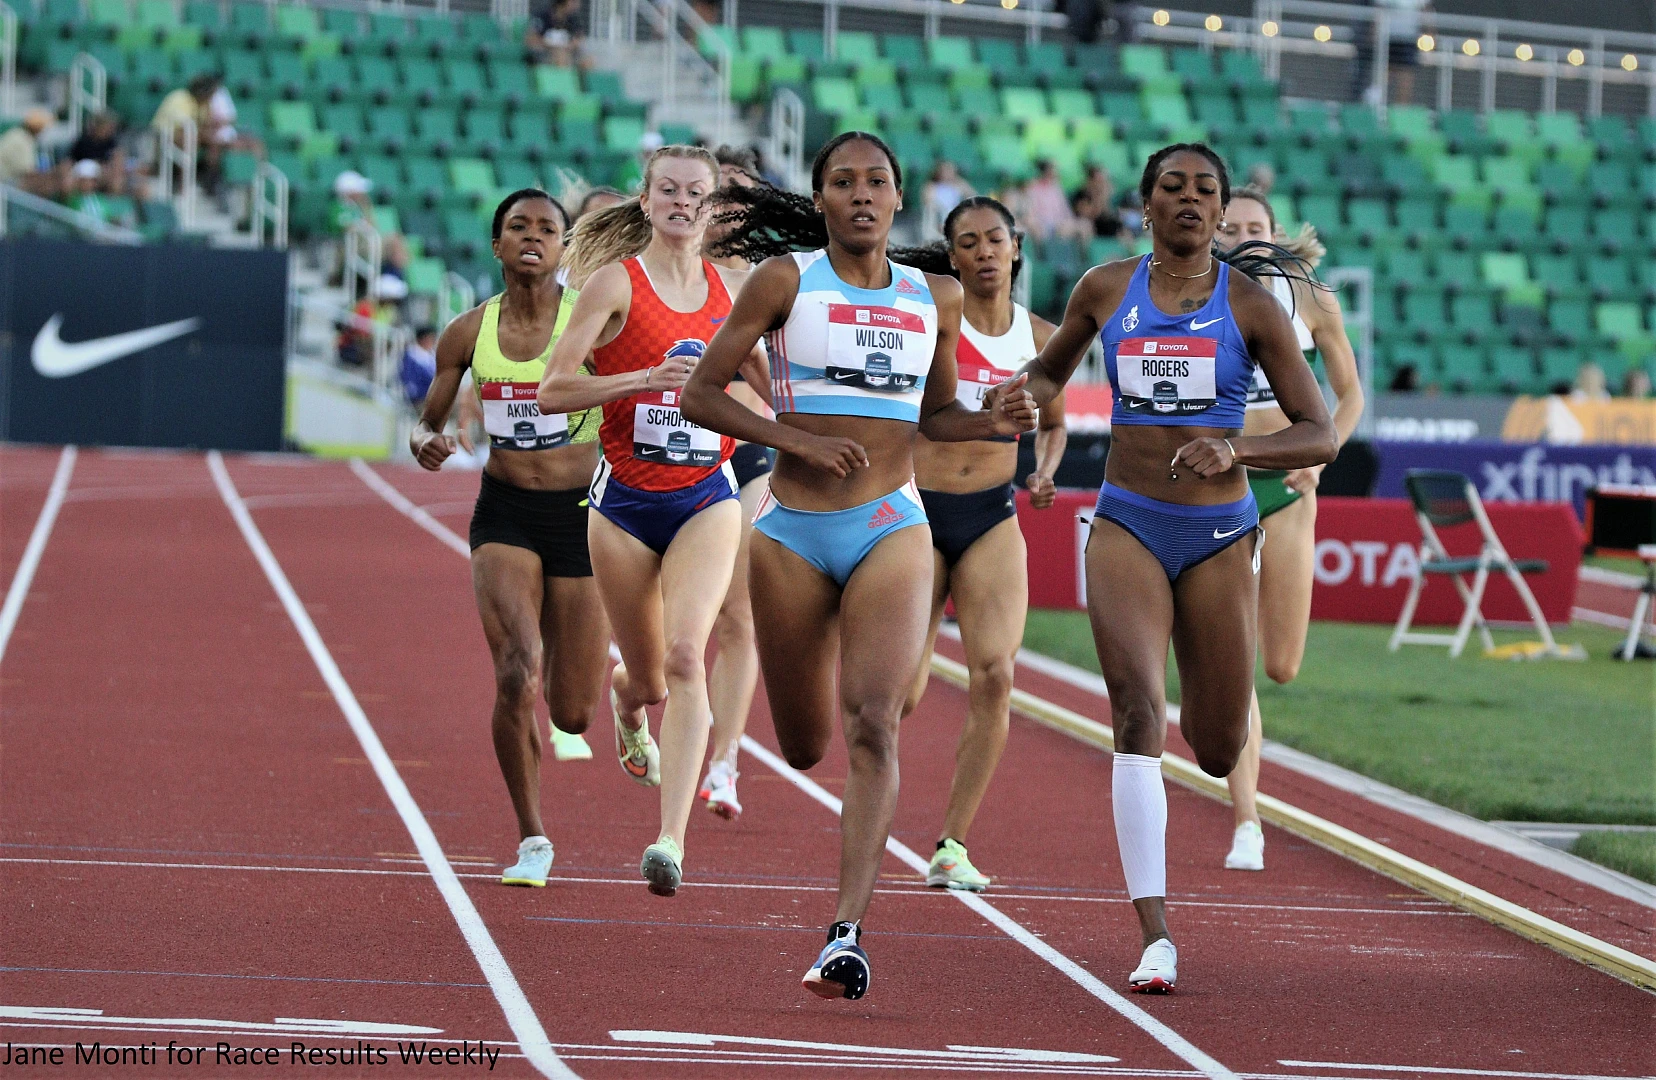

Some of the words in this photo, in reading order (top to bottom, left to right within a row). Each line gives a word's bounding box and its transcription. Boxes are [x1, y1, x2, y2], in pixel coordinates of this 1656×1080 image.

[872, 313, 901, 324] TOYOTA
[855, 328, 904, 351] WILSON
[1142, 359, 1189, 377] ROGERS
[991, 373, 1011, 382] TOYO
[507, 403, 540, 418] AKINS
[646, 408, 701, 430] SCHO
[868, 513, 905, 528] adidas
